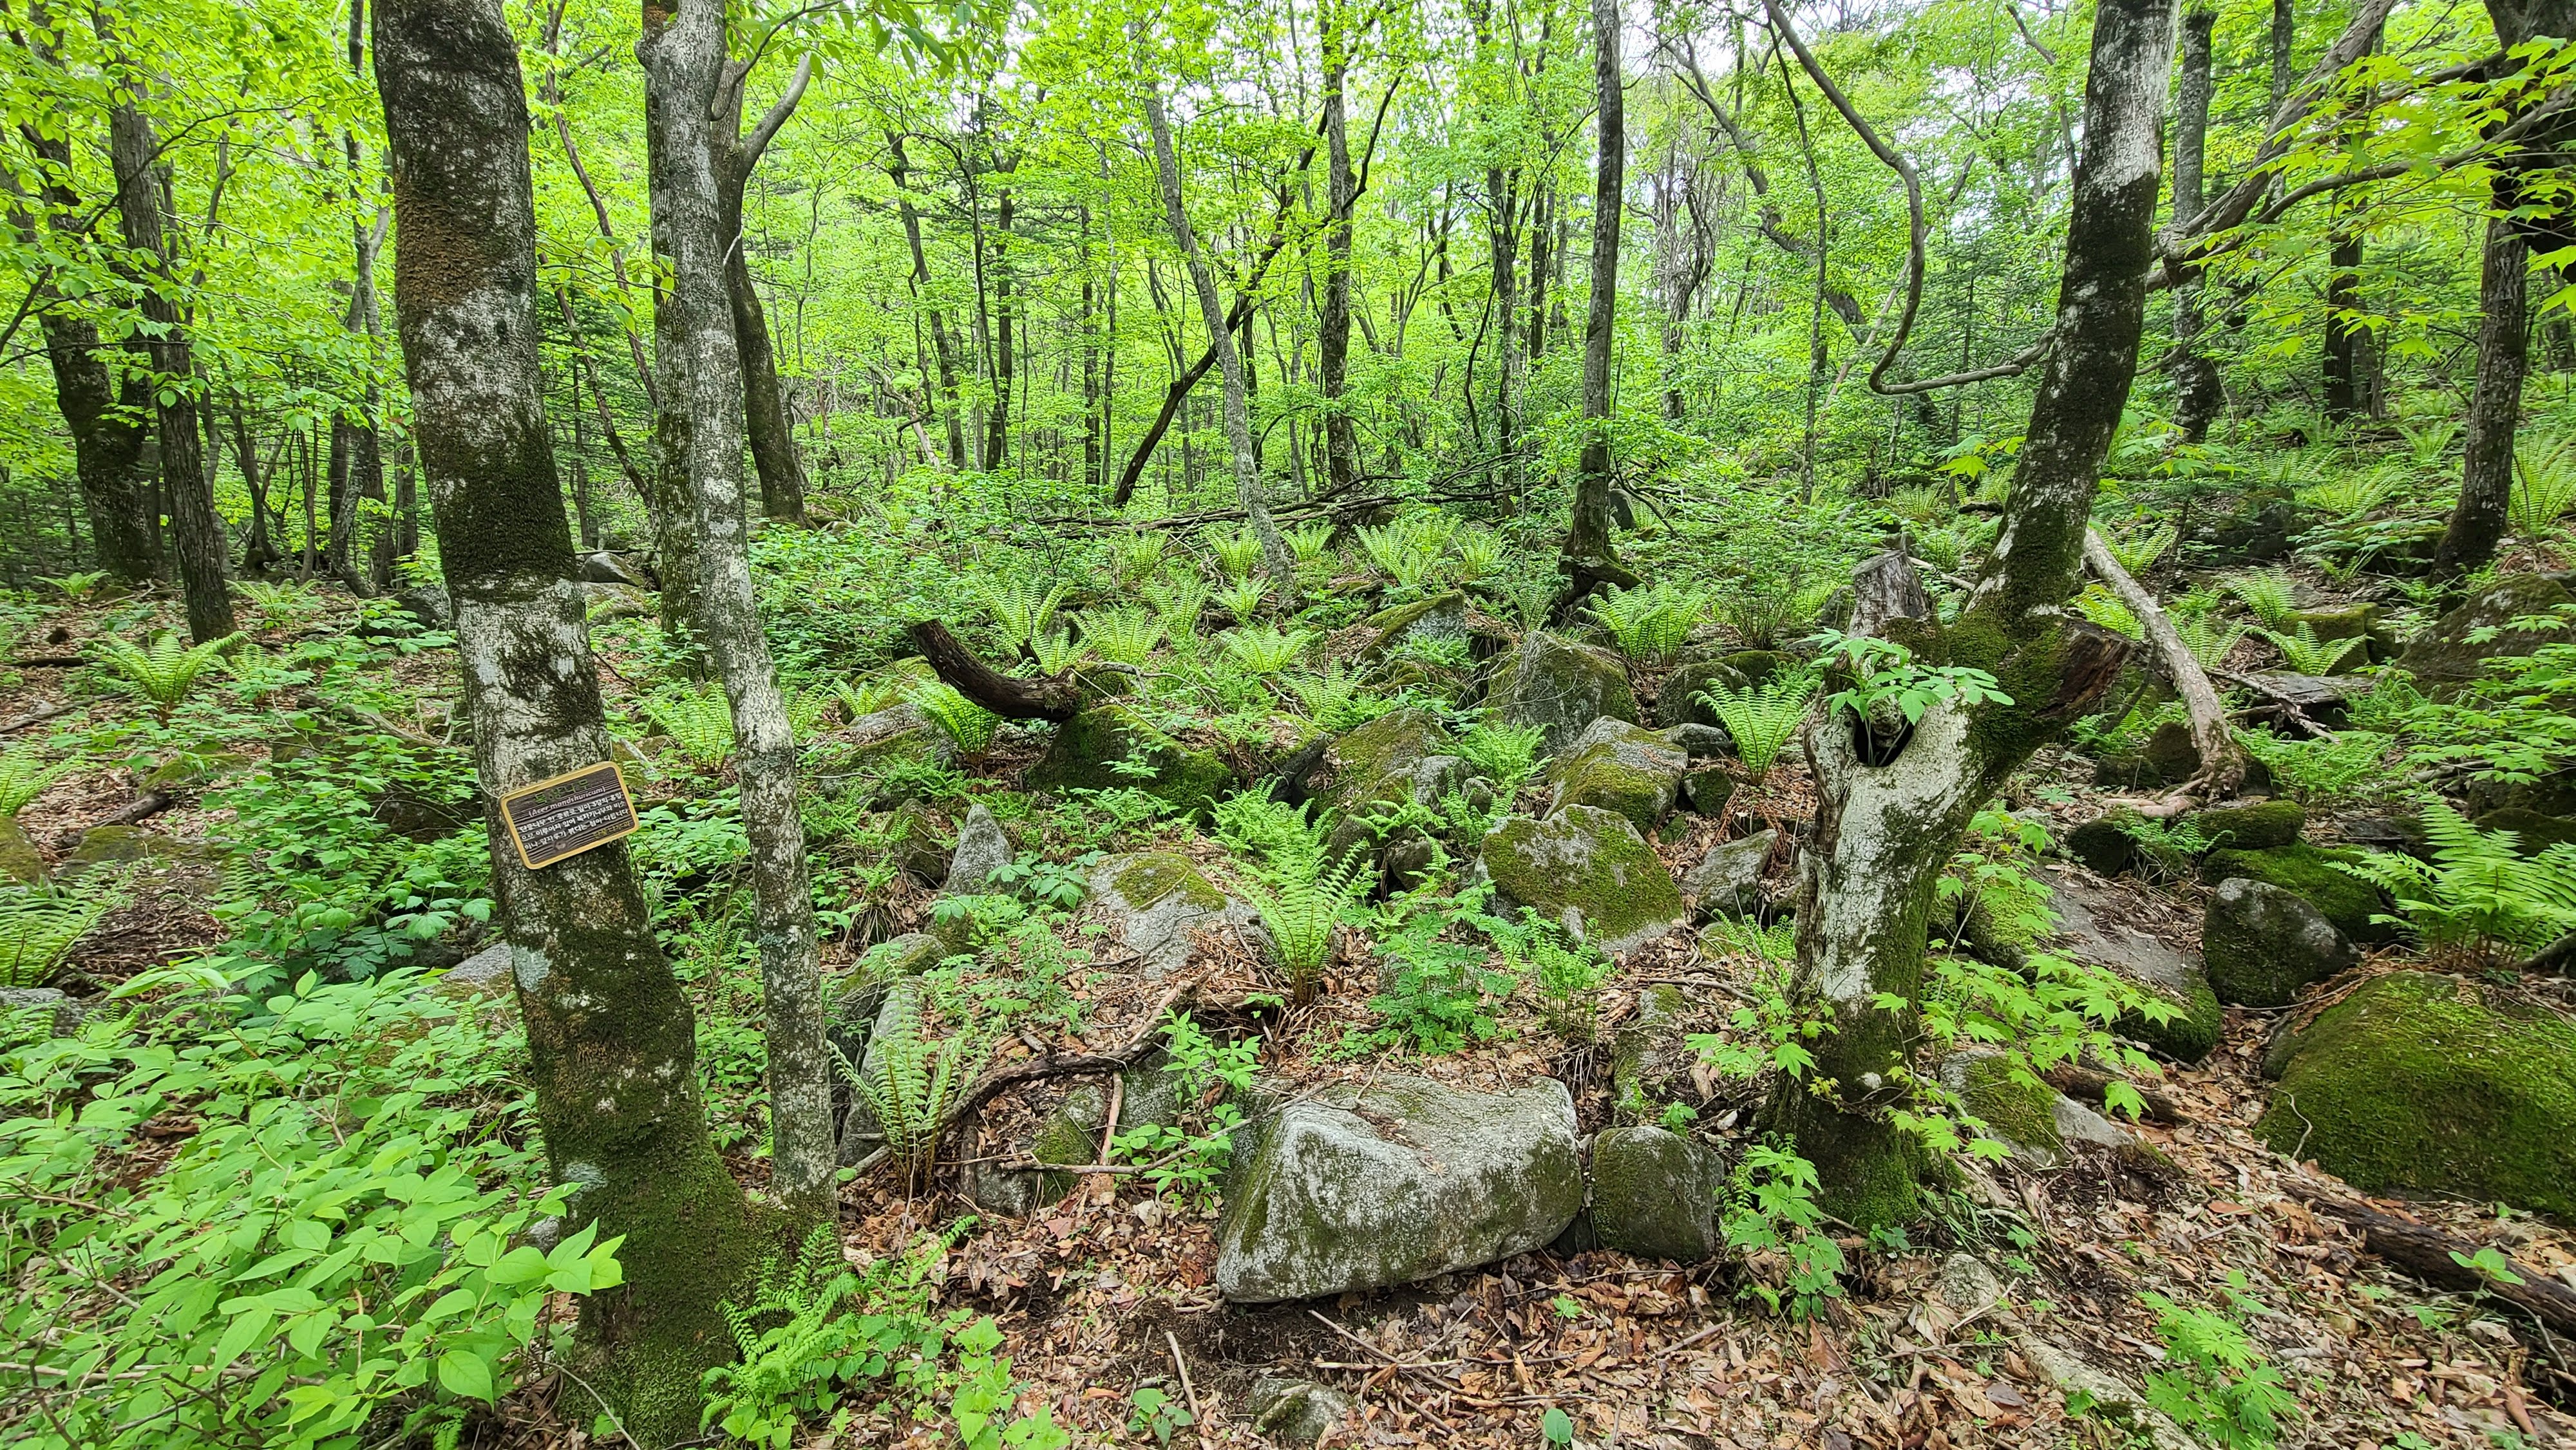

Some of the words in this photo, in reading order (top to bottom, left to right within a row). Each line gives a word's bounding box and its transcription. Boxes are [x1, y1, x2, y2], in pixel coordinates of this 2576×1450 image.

[529, 805, 548, 817] (Acer
[520, 820, 546, 832] 단풍나무
[577, 803, 590, 813] 잎이
[562, 817, 576, 827] 있어
